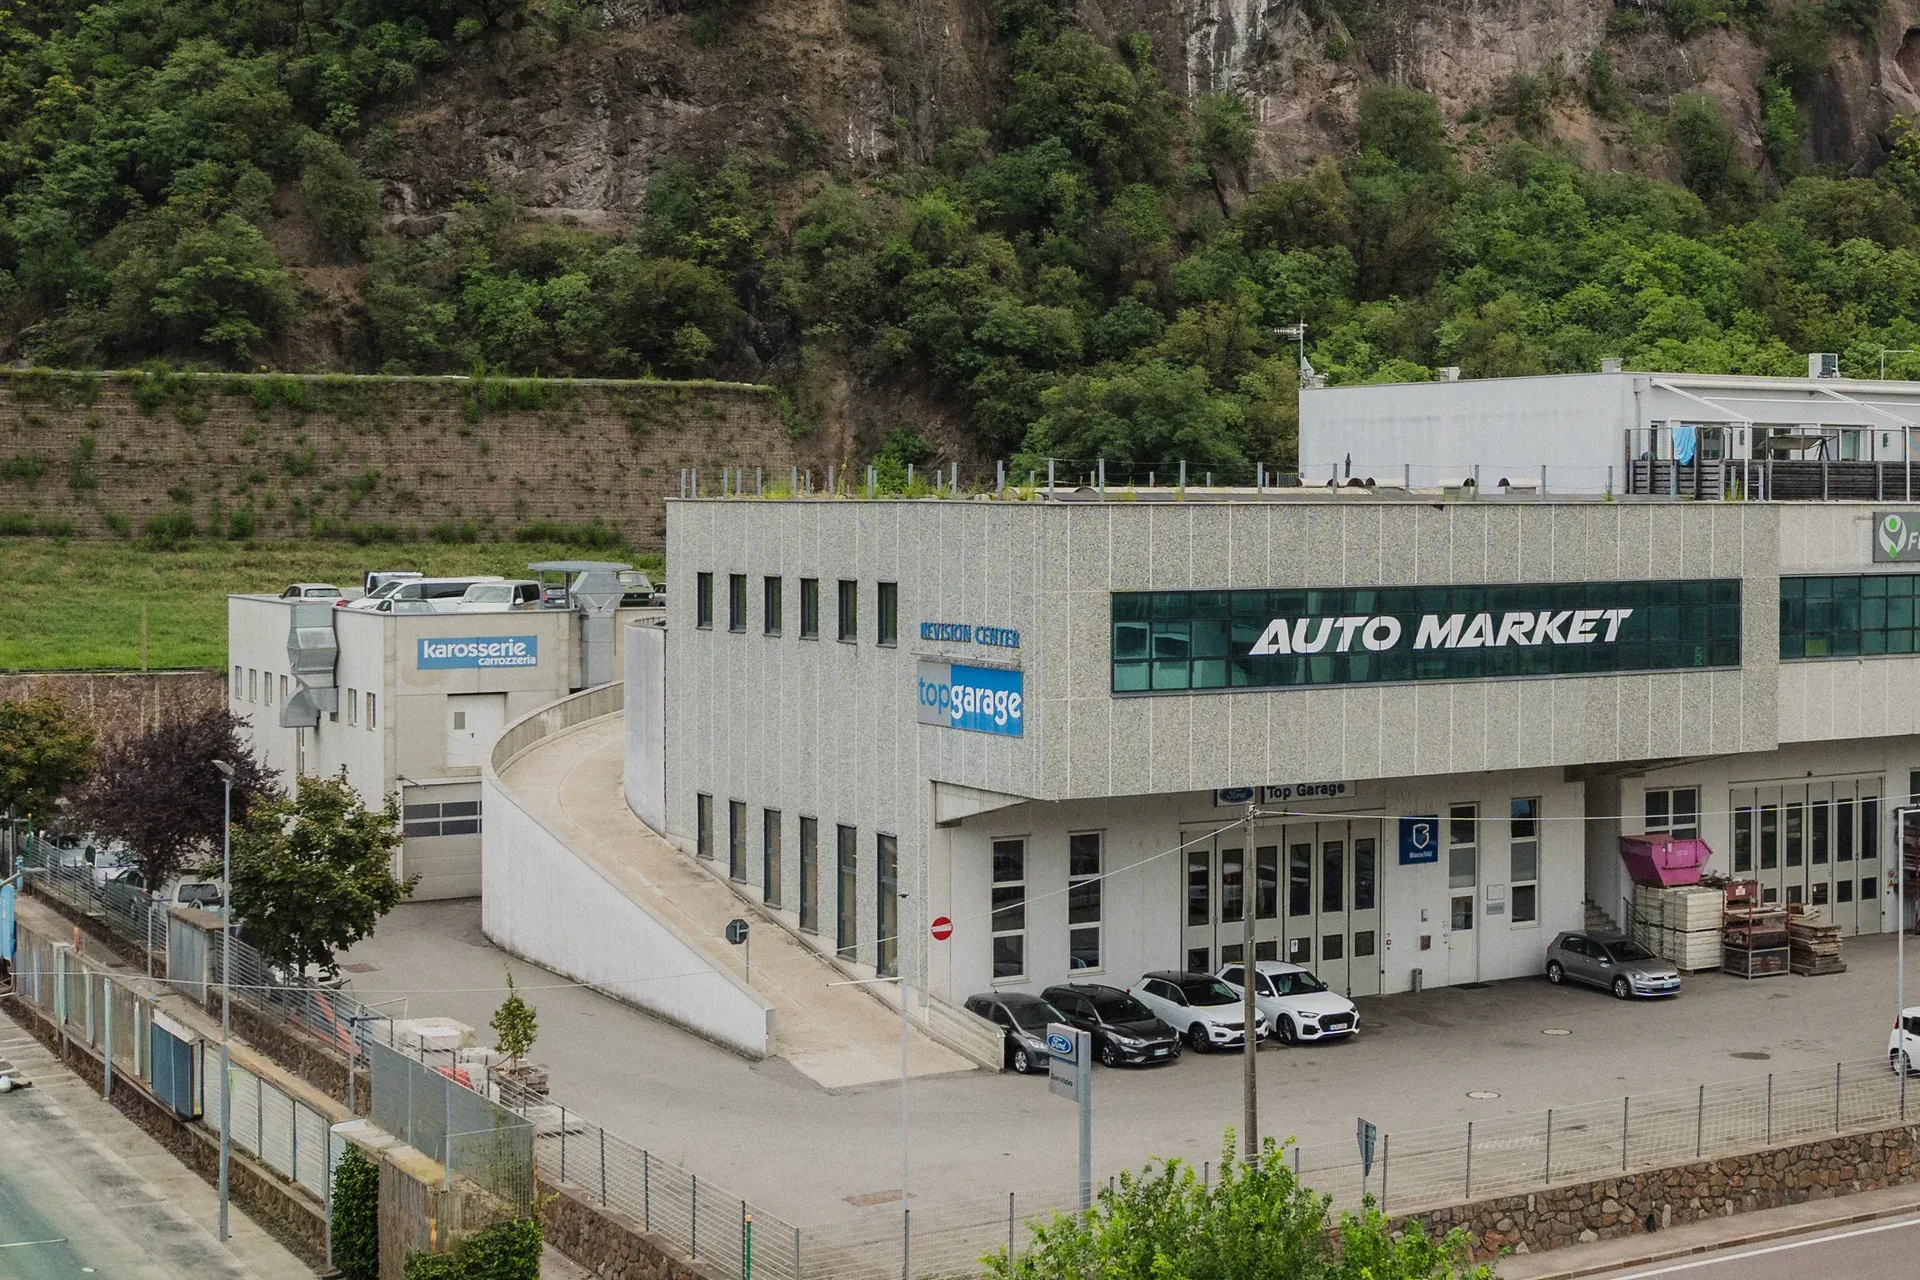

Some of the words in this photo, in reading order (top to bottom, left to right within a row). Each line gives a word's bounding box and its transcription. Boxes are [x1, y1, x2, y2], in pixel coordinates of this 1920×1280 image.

[920, 622, 971, 643] REVISION
[974, 626, 1020, 649] CENTER
[1249, 616, 1401, 655] AUTO
[1413, 609, 1634, 649] MARKET
[423, 638, 526, 659] karosserie
[478, 654, 536, 666] carrozzeria
[1267, 785, 1292, 800] Top
[1296, 783, 1345, 797] Garage
[1050, 1073, 1074, 1087] Servizio
